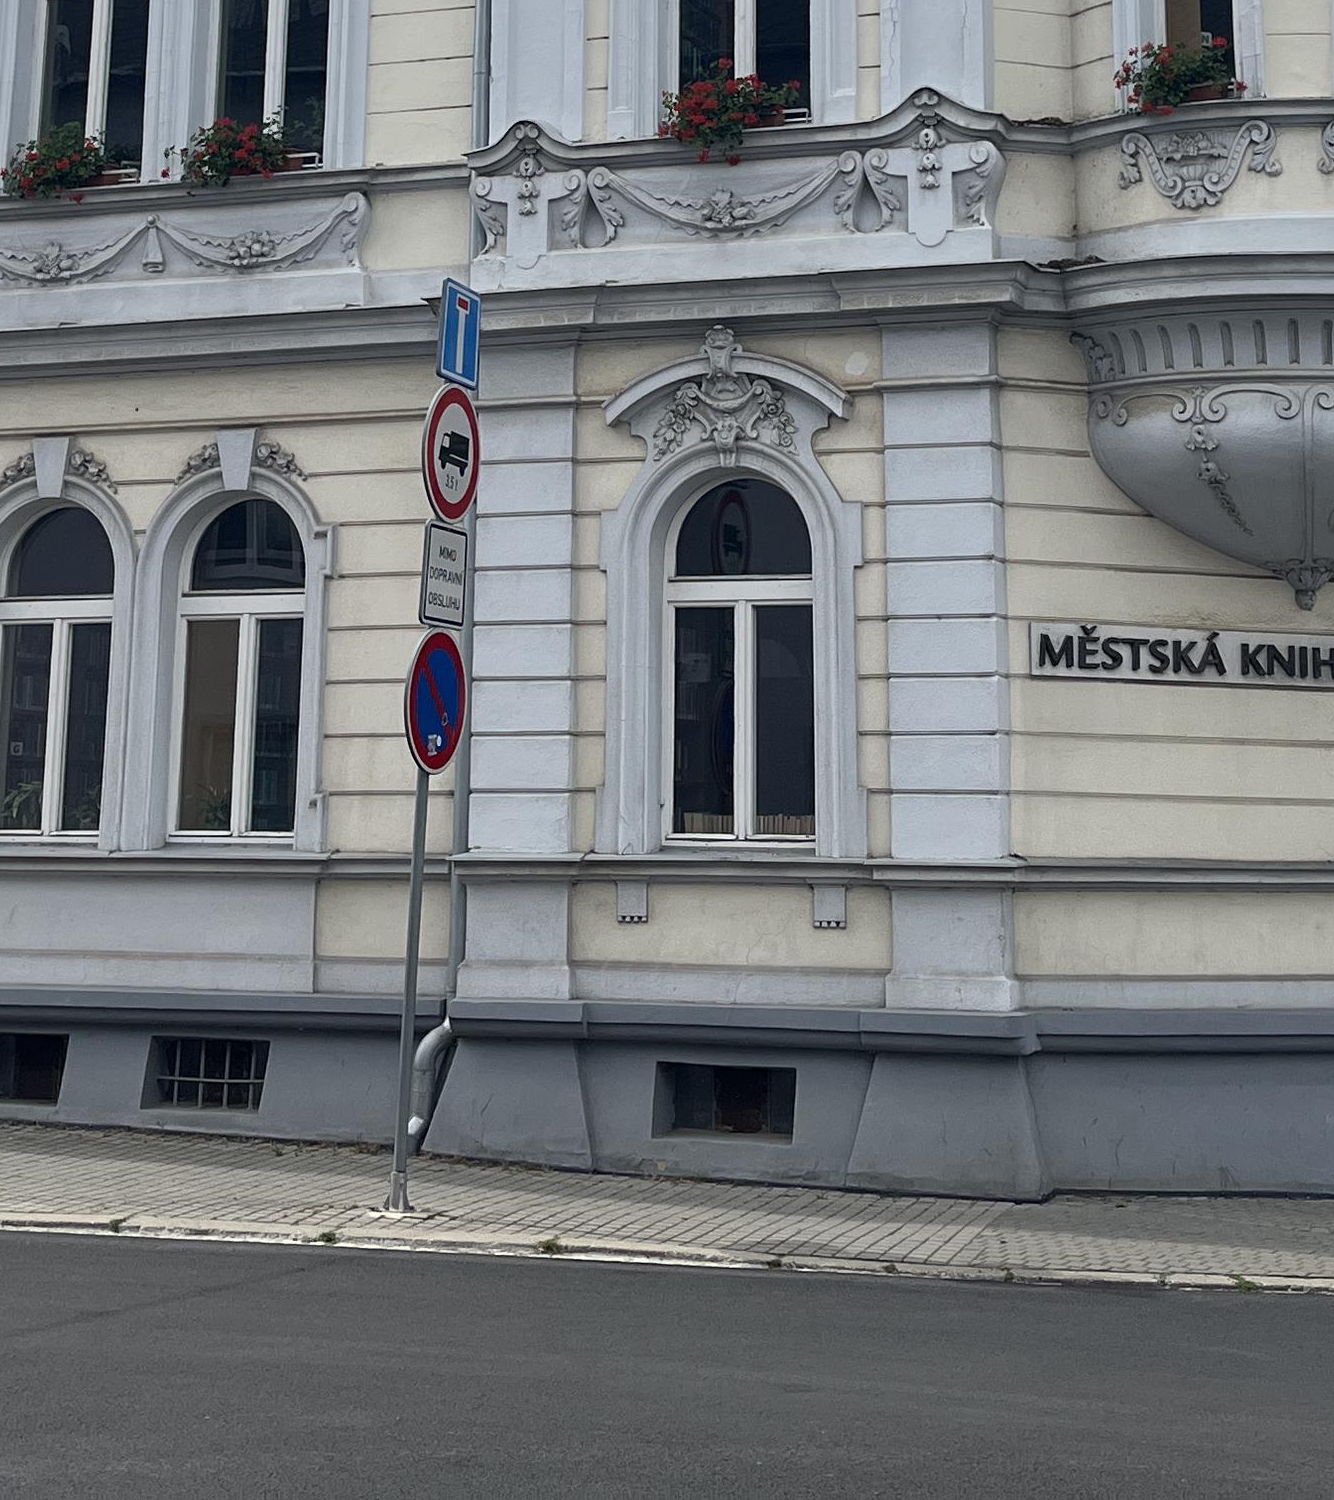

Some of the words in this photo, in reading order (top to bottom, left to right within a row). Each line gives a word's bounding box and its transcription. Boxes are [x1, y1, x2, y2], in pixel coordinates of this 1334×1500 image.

[439, 545, 457, 562] MIMO
[428, 591, 460, 611] OBSLUHU
[1037, 625, 1227, 676] MĚSTSKÁ
